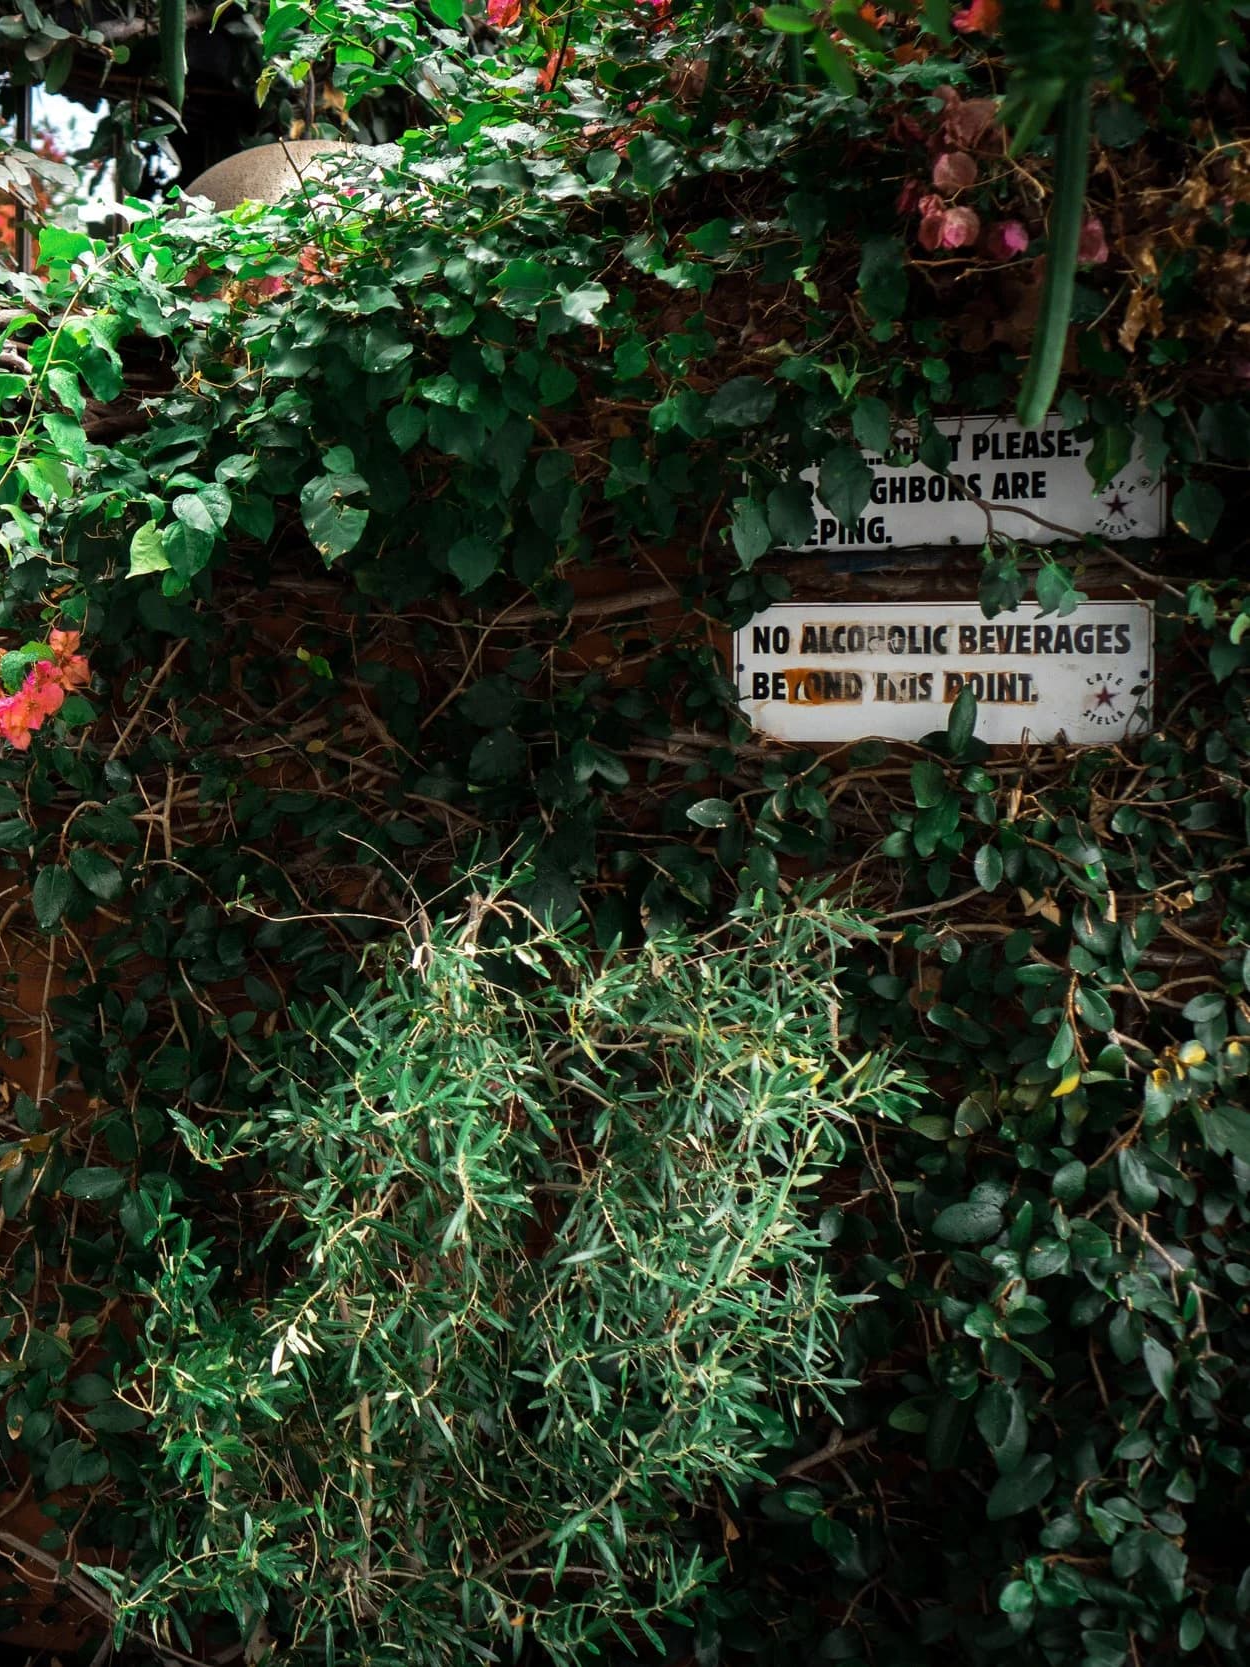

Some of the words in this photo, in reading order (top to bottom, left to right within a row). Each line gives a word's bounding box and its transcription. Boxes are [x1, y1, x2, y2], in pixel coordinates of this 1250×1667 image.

[972, 430, 1081, 461] PLEASE.
[870, 472, 982, 504] GHBORS
[992, 471, 1047, 499] ARE
[1101, 481, 1136, 494] AFE
[1095, 519, 1138, 534] STELLA
[753, 626, 790, 654] NO
[801, 625, 948, 654] ALCOHOLIC
[959, 624, 1131, 654] BEVERAGES
[944, 672, 1039, 703] POINT.
[1086, 672, 1124, 686] CAFE
[1083, 709, 1125, 725] STELLA
